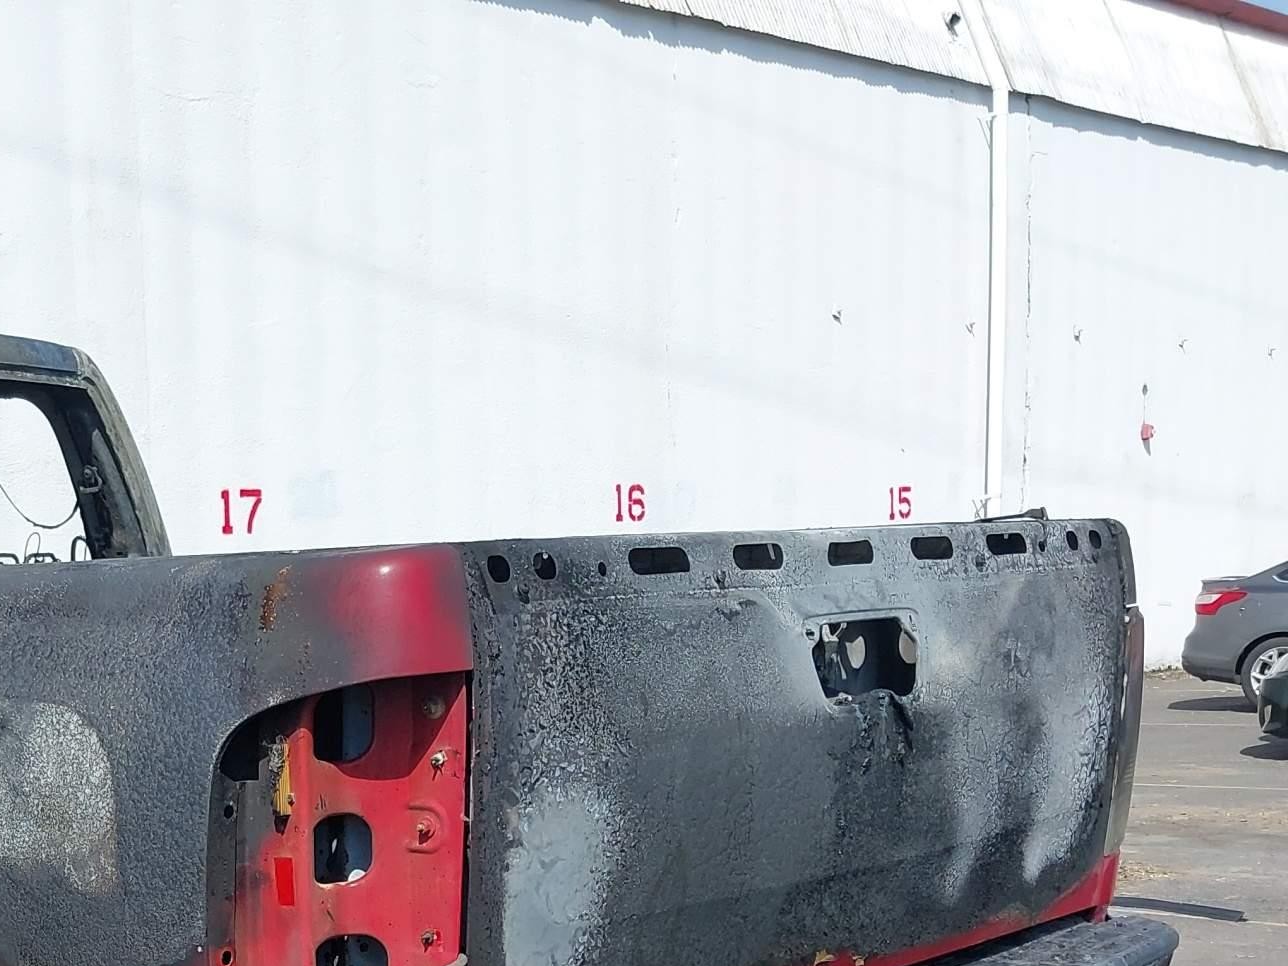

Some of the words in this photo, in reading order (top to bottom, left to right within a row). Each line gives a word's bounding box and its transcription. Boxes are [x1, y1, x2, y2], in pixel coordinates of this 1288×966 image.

[221, 488, 262, 535] 17
[615, 484, 645, 521] 16
[890, 486, 911, 518] 15
